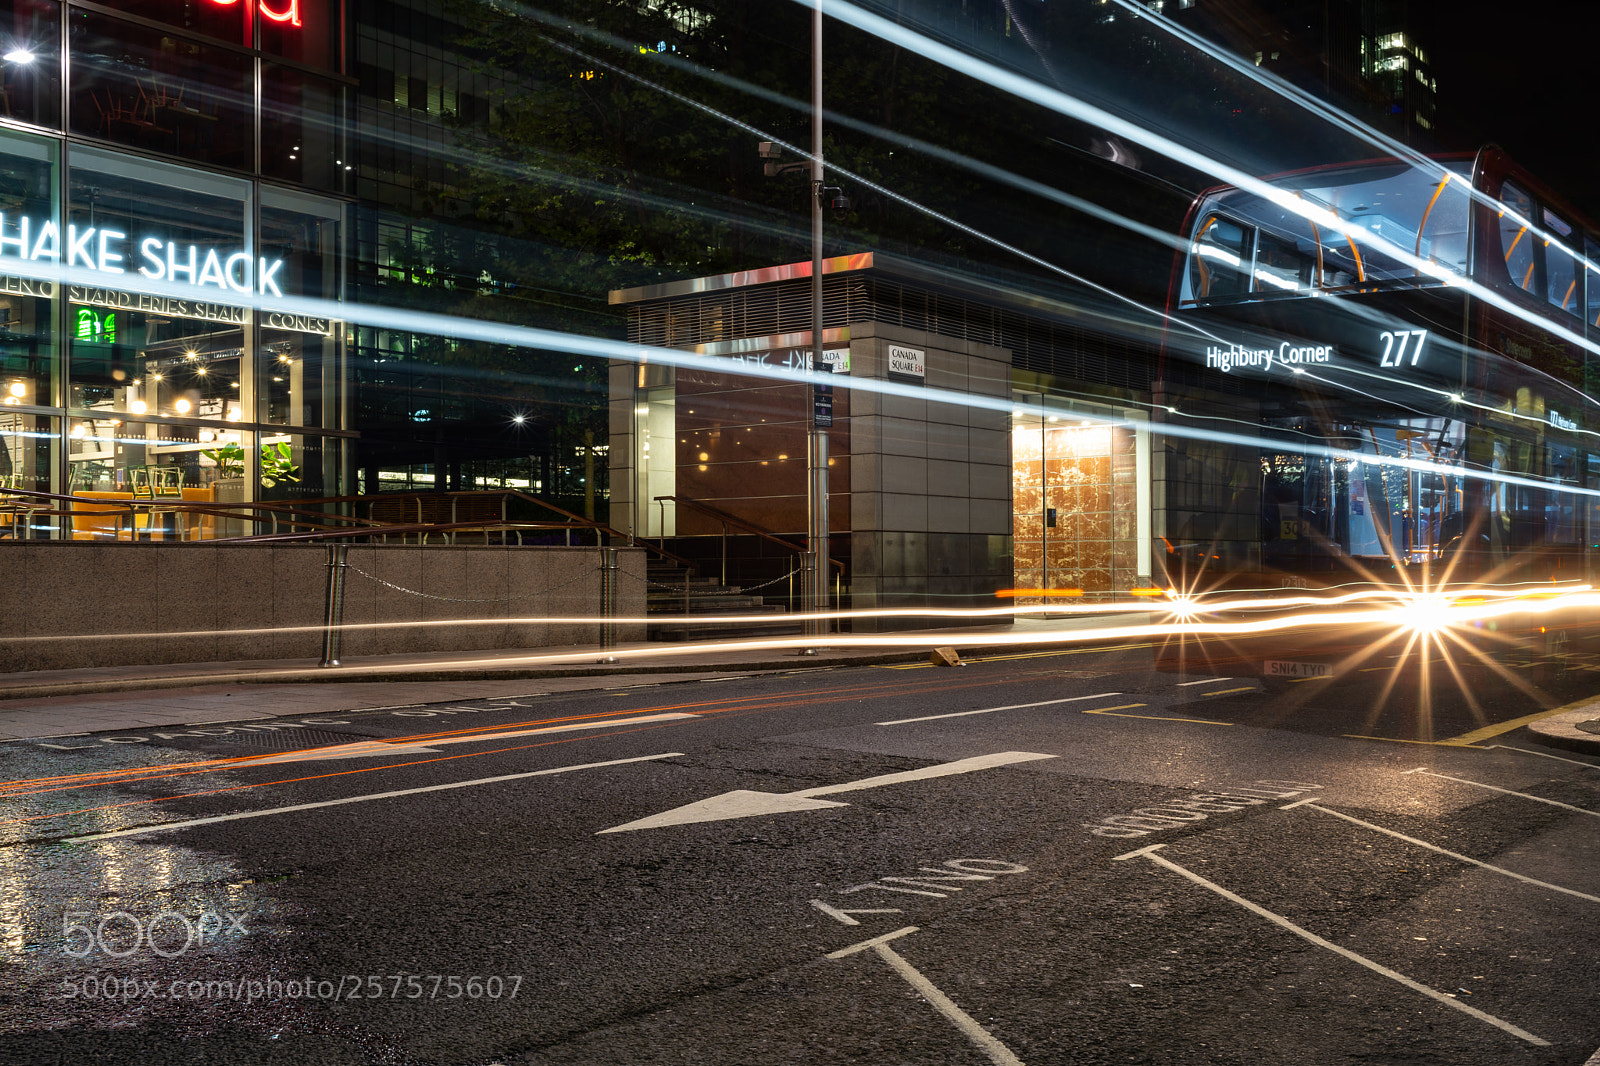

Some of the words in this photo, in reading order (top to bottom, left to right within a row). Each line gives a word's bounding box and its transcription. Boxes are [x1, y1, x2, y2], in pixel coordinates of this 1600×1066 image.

[138, 237, 283, 298] SHACK
[0, 275, 33, 296] EN
[39, 281, 130, 308] CSTARD
[139, 293, 187, 316] FRIES
[269, 313, 326, 333] CONES
[891, 348, 917, 361] CANADA
[891, 359, 913, 371] SQUARE
[914, 363, 923, 373] E14
[1206, 345, 1274, 372] Highbury
[1279, 341, 1333, 364] Corner
[1380, 329, 1428, 368] 277
[1271, 662, 1298, 674] SN14
[36, 717, 352, 751] LOADING
[391, 700, 533, 718] ONLY
